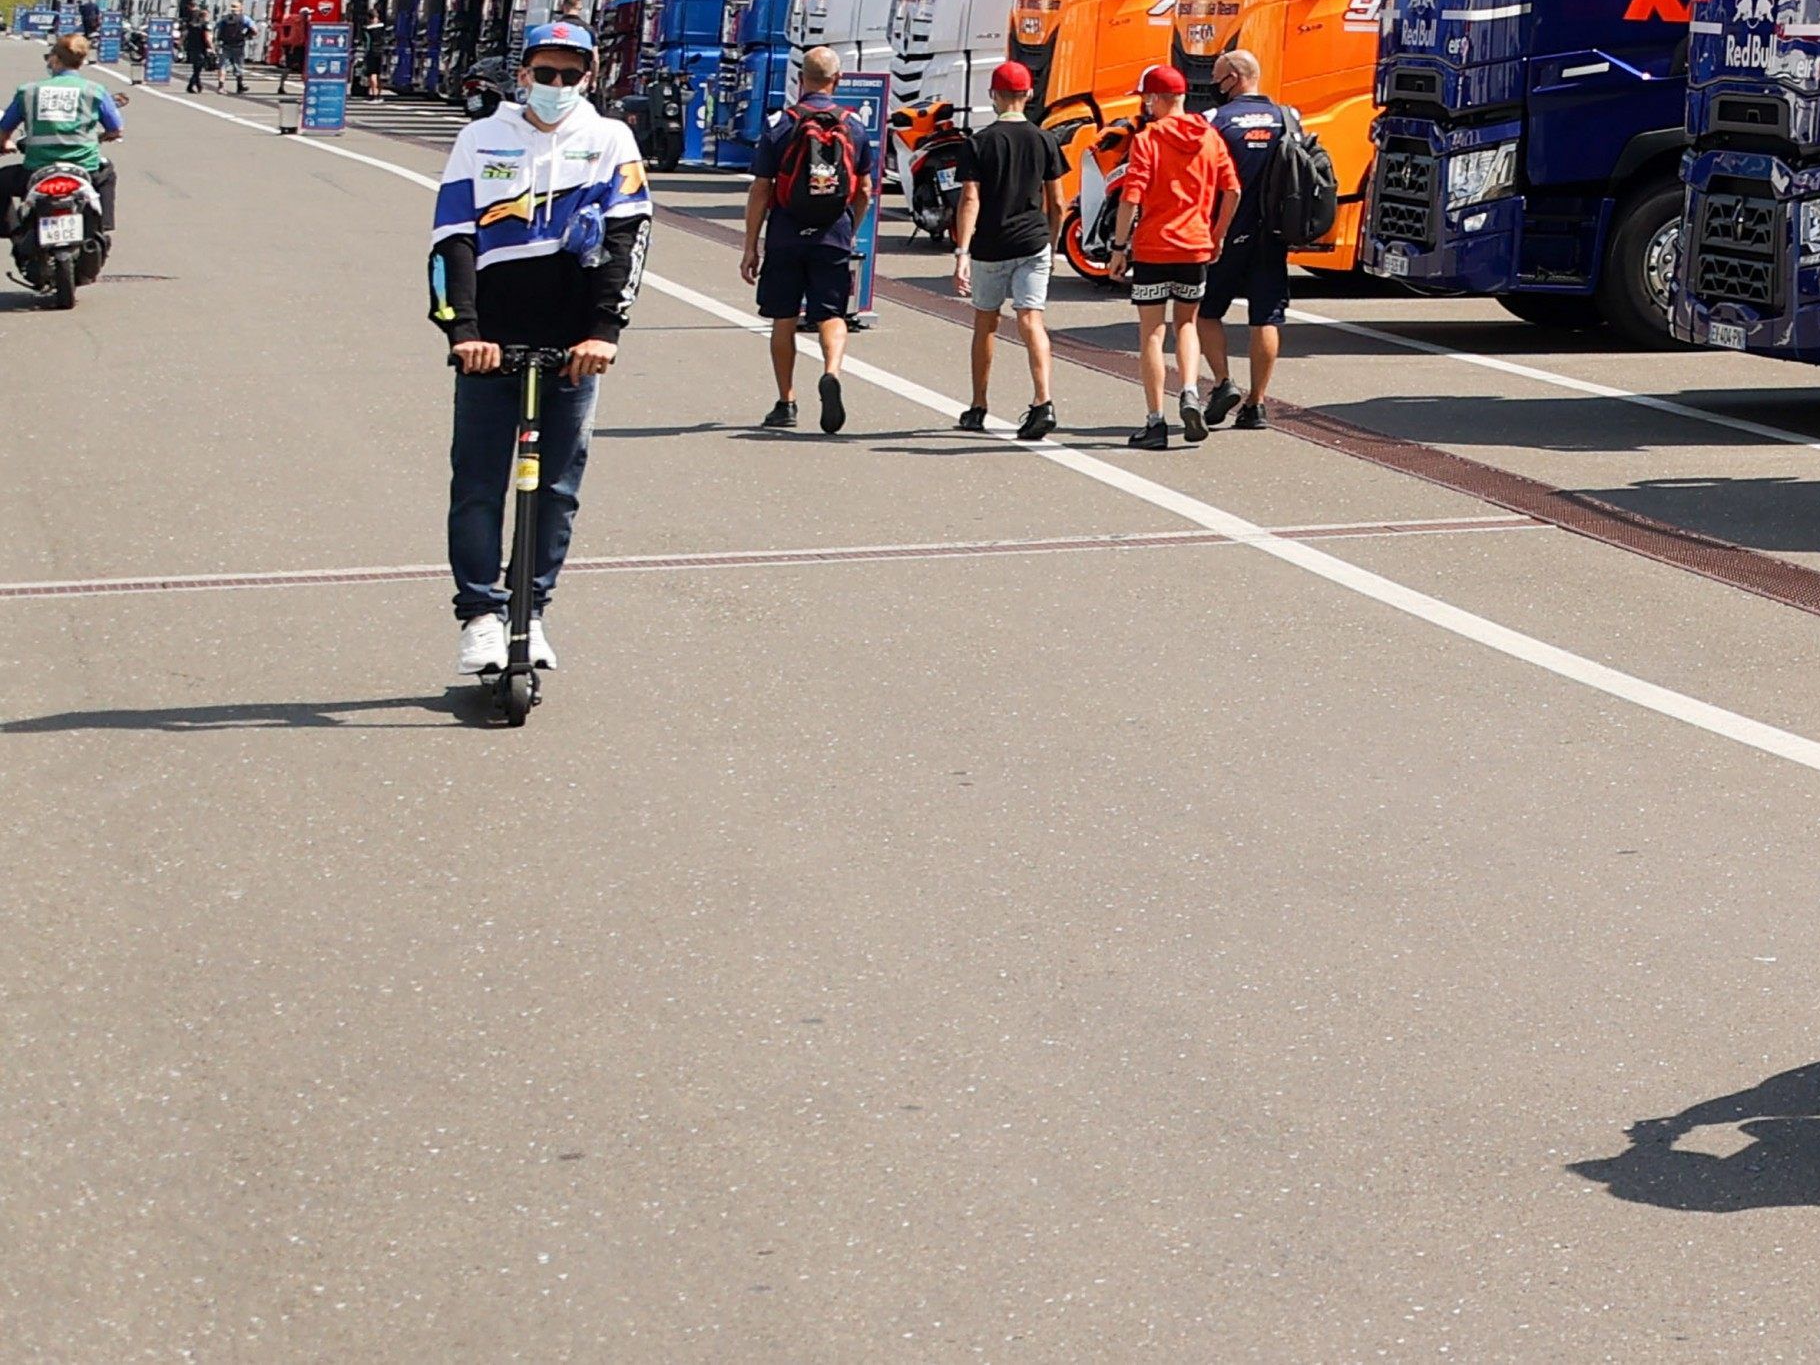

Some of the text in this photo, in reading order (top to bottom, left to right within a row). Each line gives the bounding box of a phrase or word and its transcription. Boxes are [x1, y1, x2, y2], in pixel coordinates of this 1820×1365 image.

[1401, 18, 1437, 47] Red Bull
[1725, 34, 1777, 70] Red Bull
